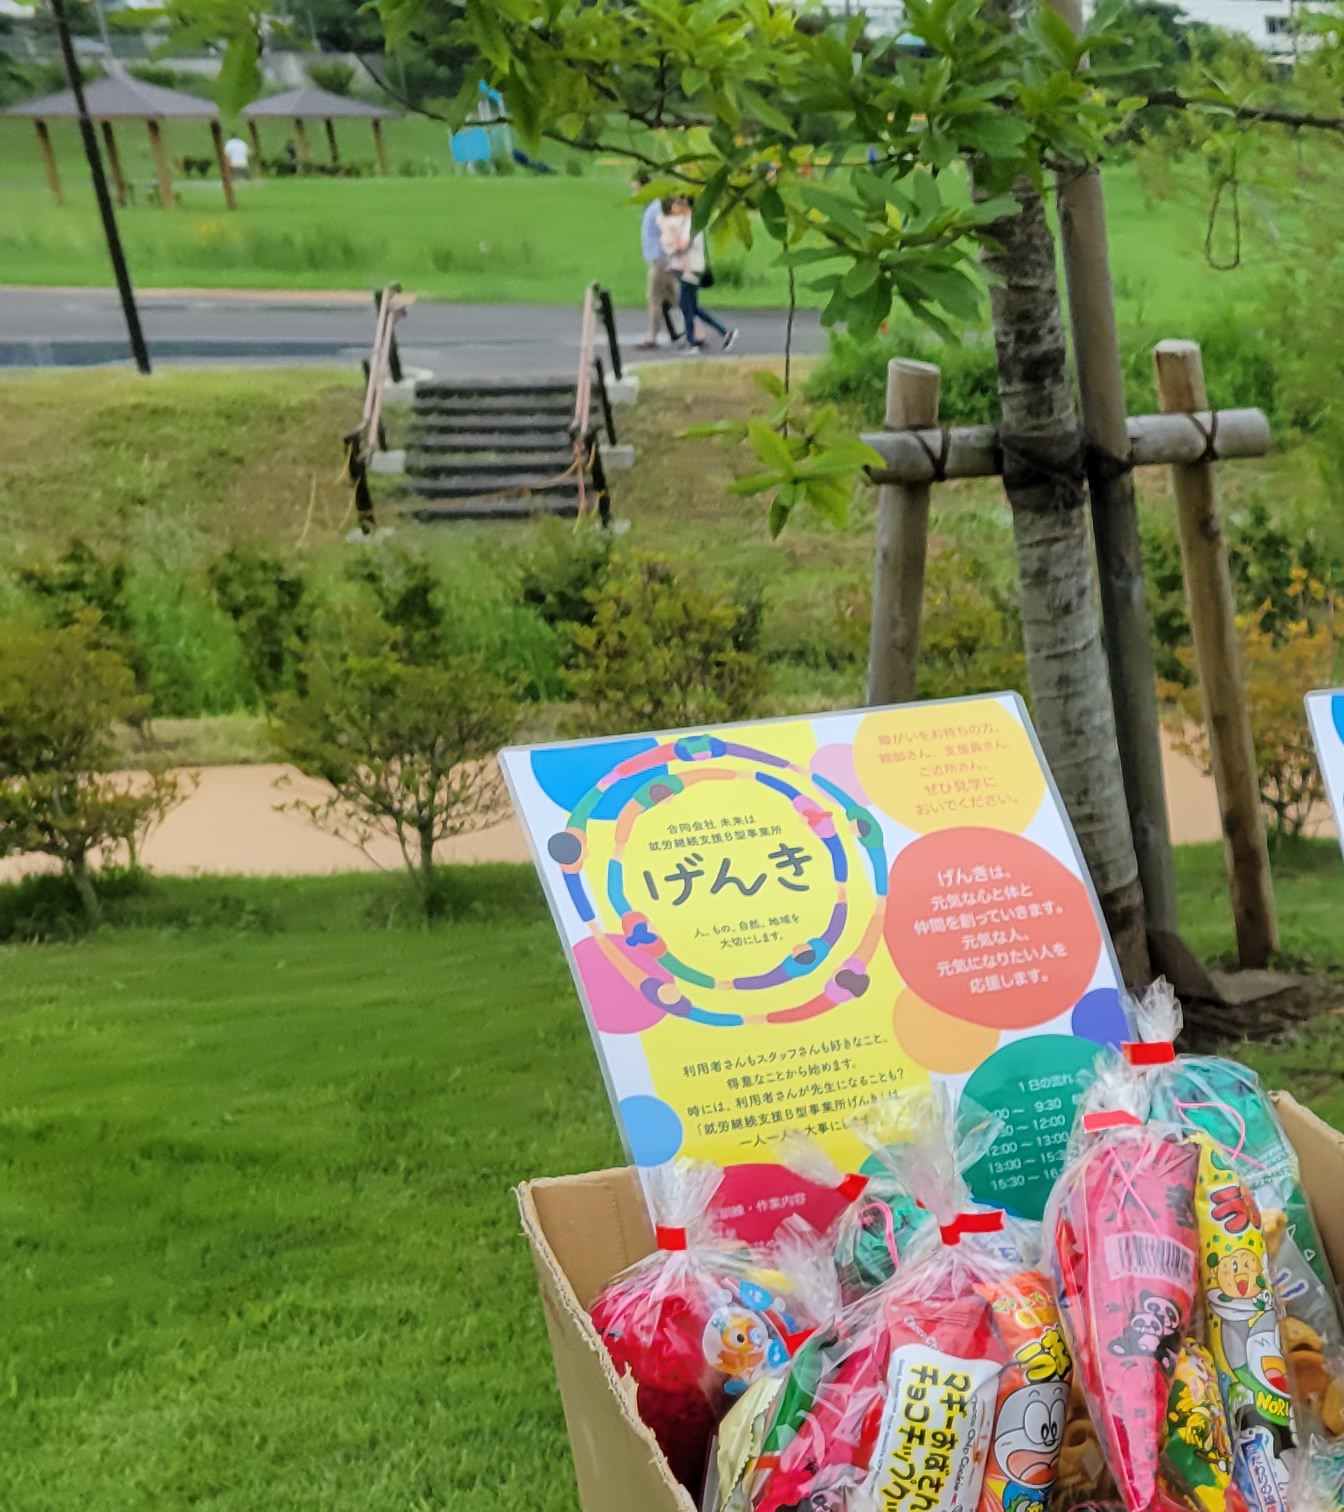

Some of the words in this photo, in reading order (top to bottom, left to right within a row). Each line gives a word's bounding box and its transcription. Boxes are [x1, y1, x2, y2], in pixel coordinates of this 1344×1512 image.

[643, 841, 814, 907] げんき
[937, 864, 1012, 888] げんきは、
